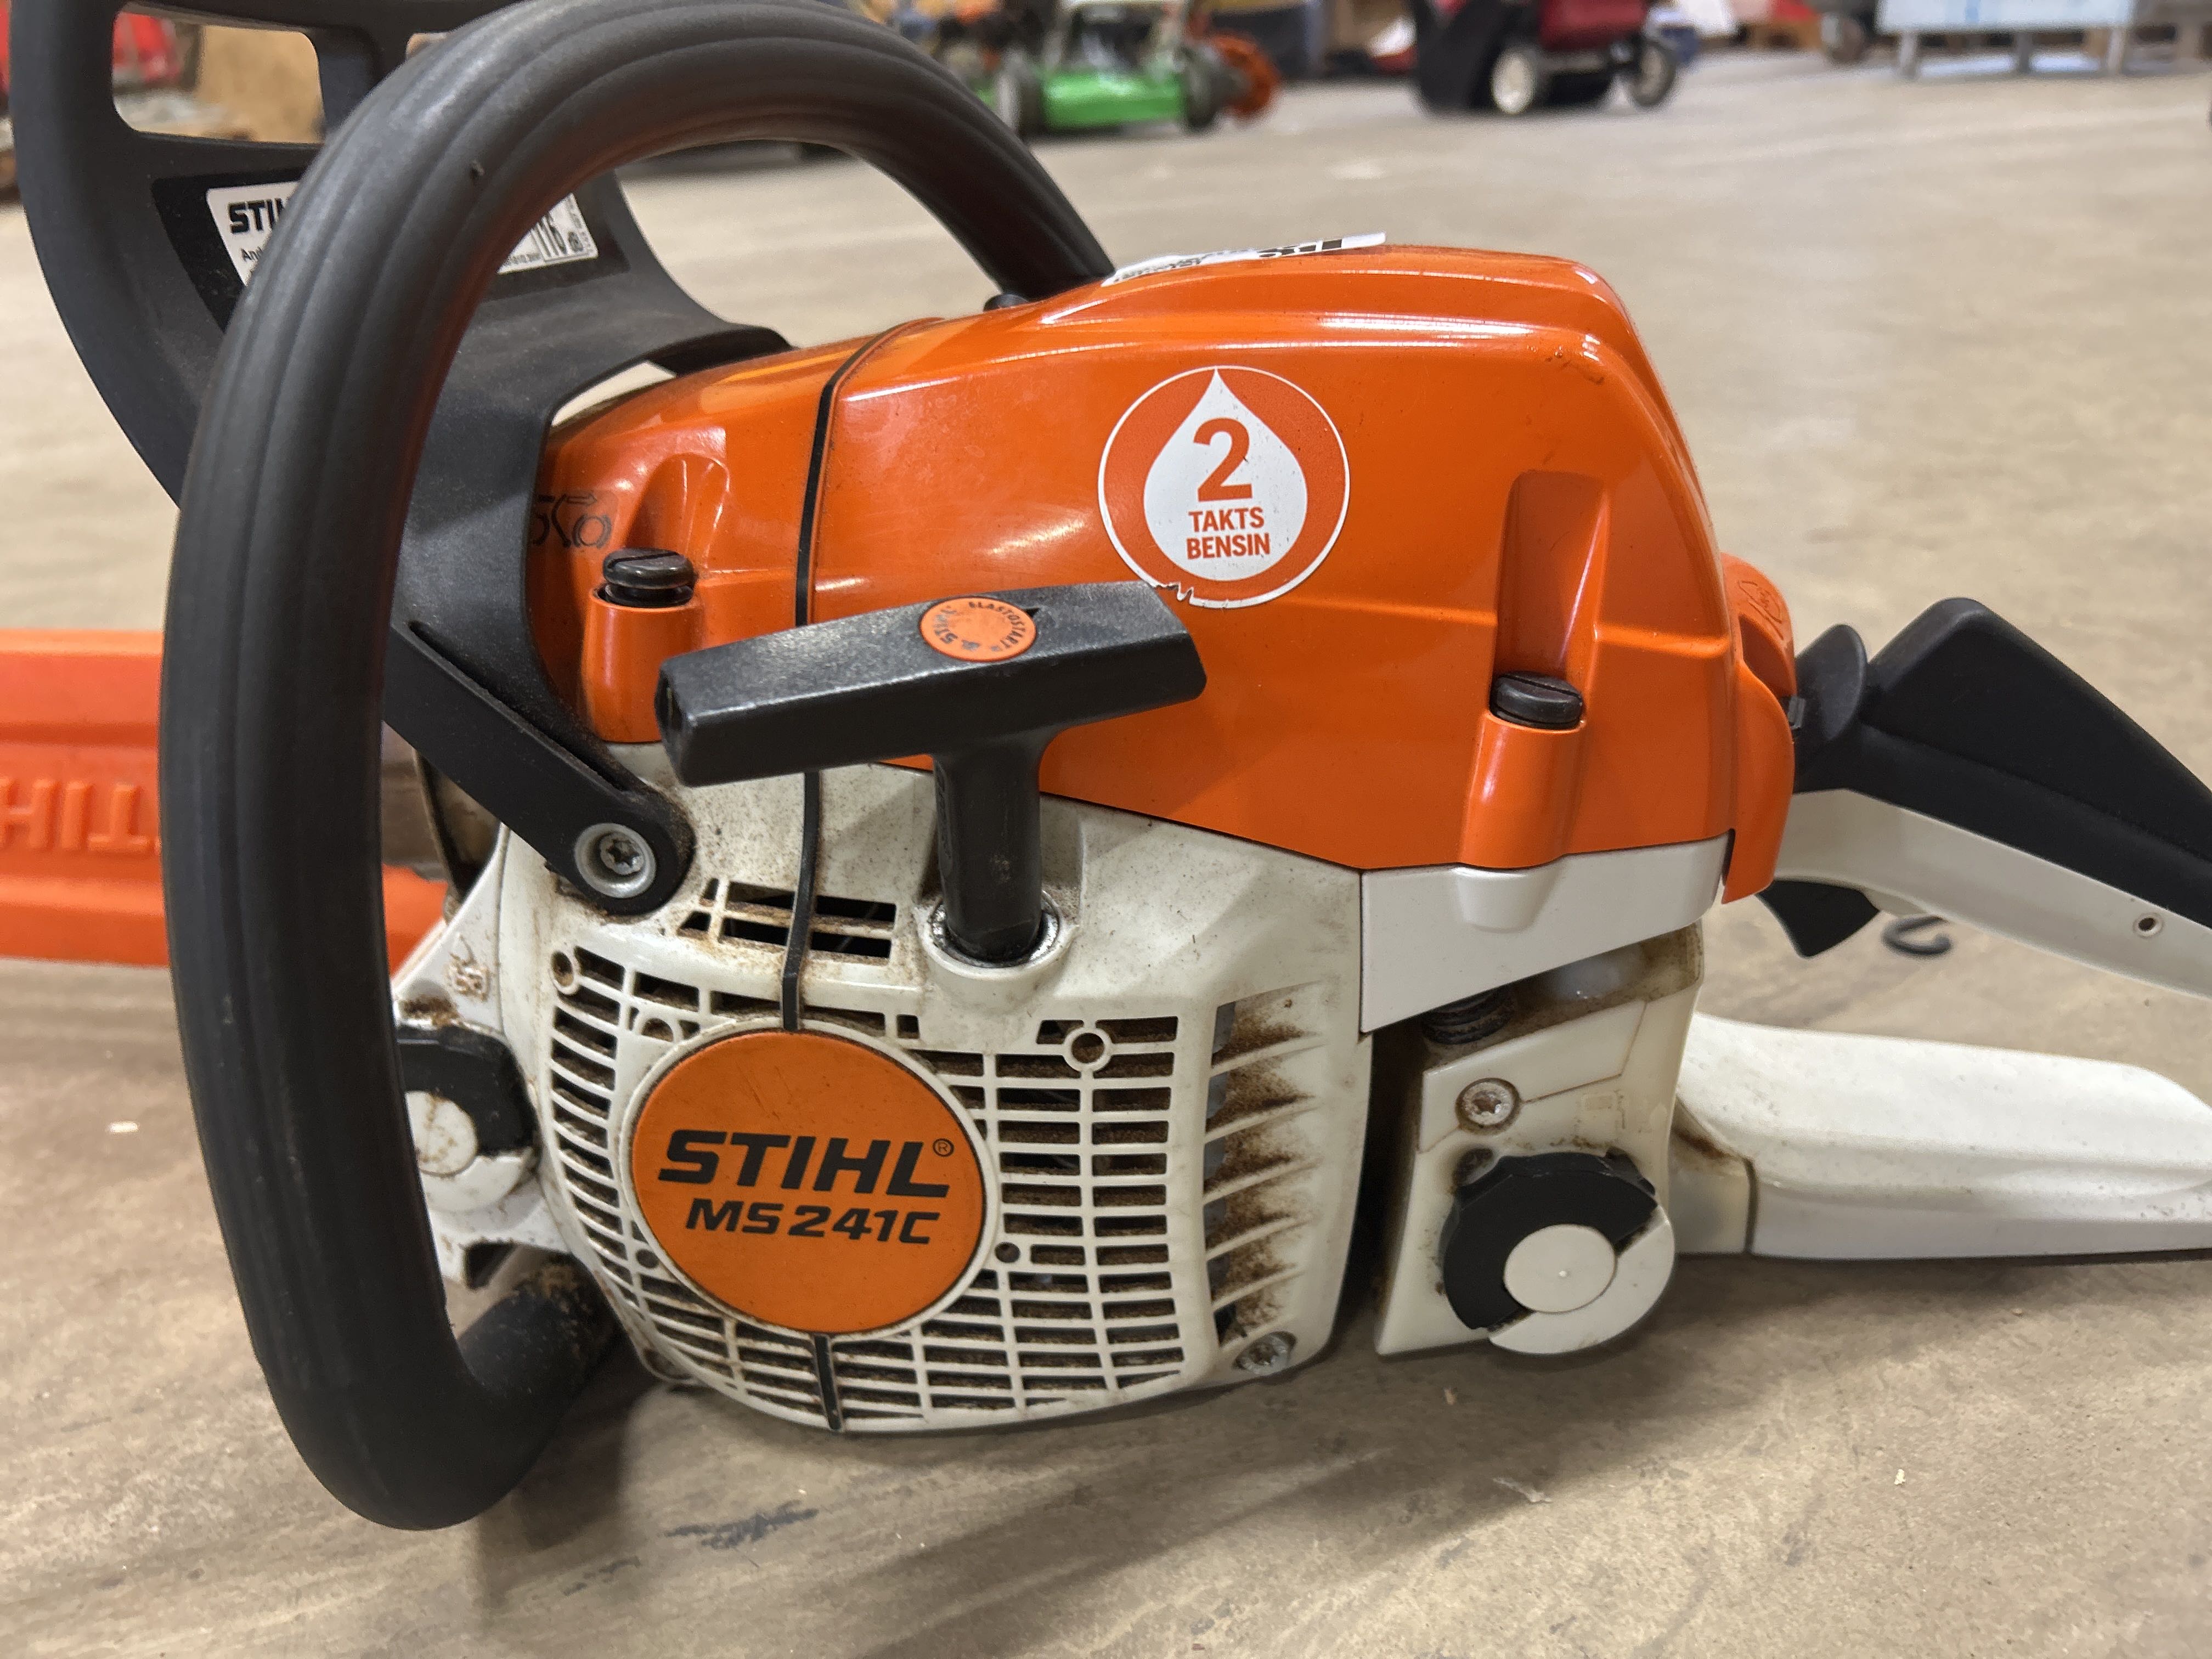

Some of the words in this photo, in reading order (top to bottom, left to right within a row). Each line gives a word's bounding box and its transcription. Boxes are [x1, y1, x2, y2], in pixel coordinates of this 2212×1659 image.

[1193, 417, 1253, 503] 2
[1188, 506, 1265, 533] TAKTS
[1186, 532, 1271, 561] BENSIN
[0, 778, 160, 854] TIH
[685, 1198, 785, 1236] MS
[787, 1204, 940, 1245] 241C
